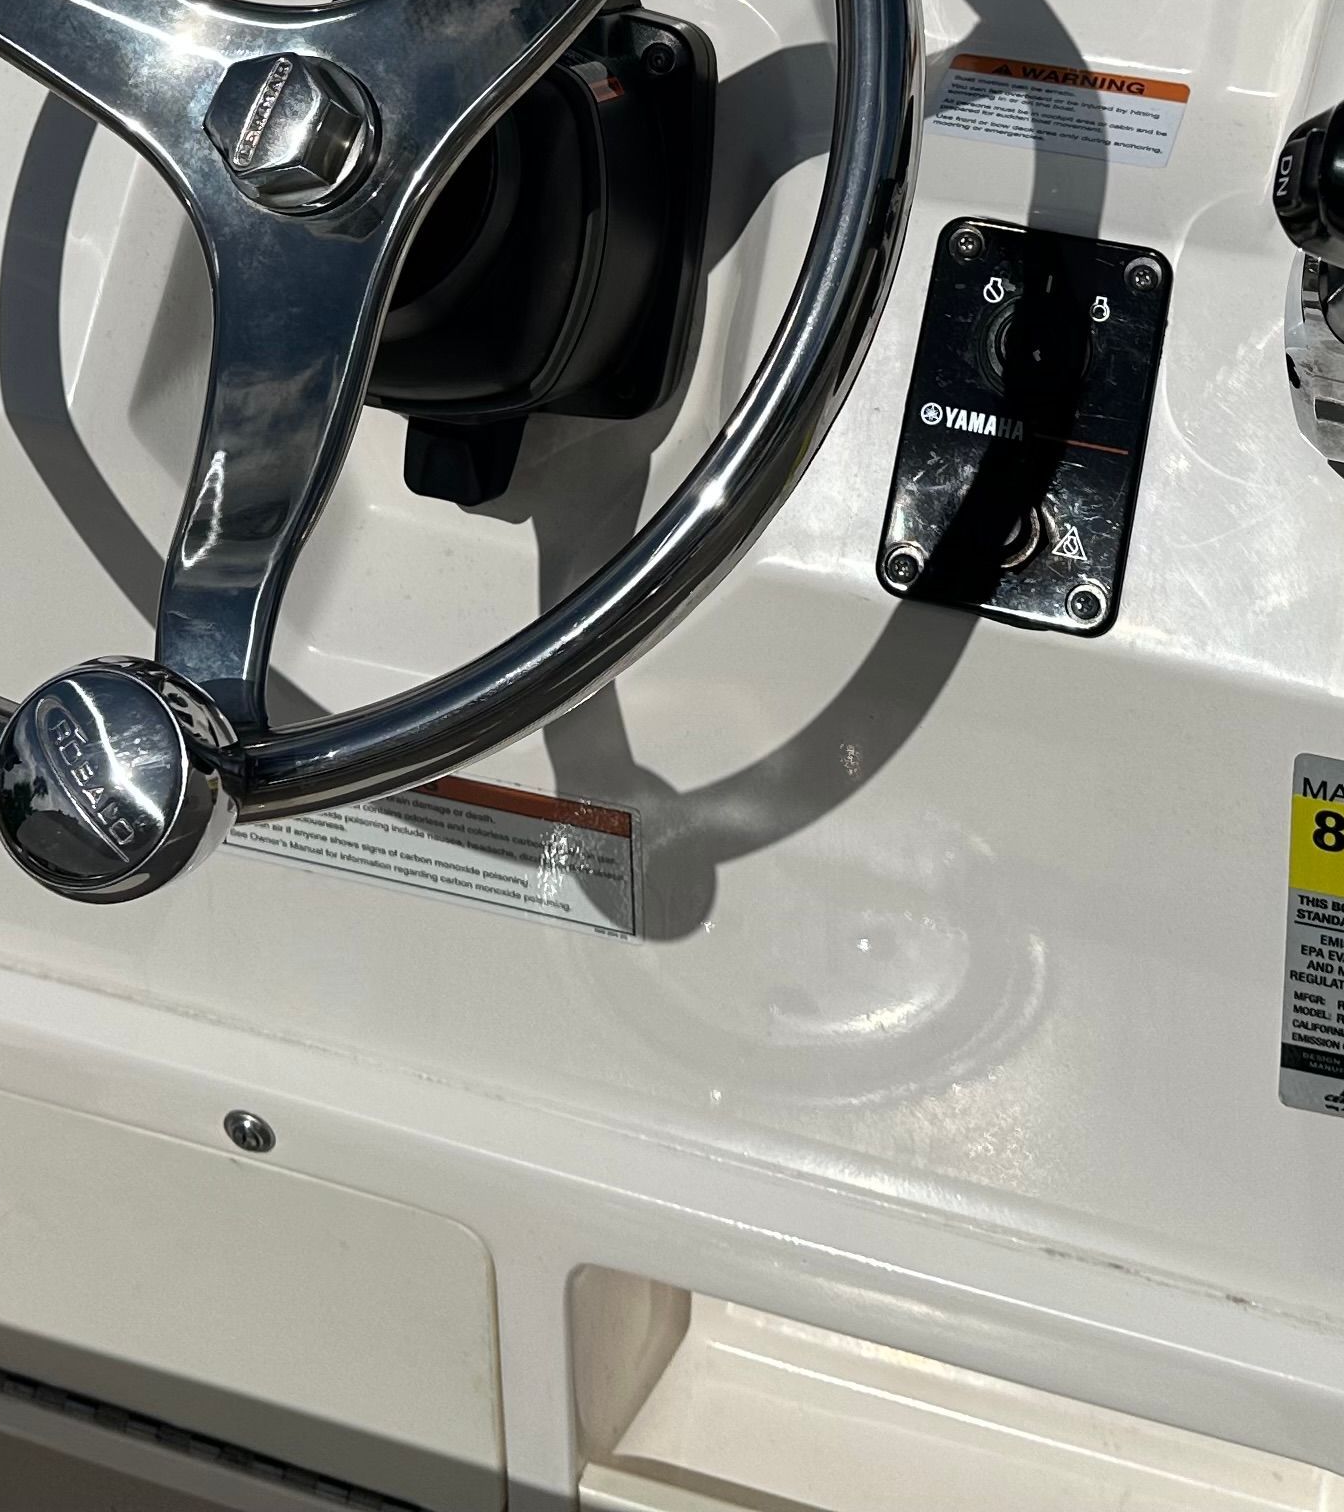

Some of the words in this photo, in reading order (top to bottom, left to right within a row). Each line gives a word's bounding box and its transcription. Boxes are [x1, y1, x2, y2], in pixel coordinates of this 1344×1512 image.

[1018, 66, 1147, 95] WARNING
[1276, 154, 1294, 198] DN
[945, 406, 1024, 441] YAMAHA
[1297, 894, 1328, 910] THIS
[1300, 944, 1325, 958] EPA
[1306, 959, 1334, 975] AND
[1291, 1031, 1340, 1050] EMISSION
